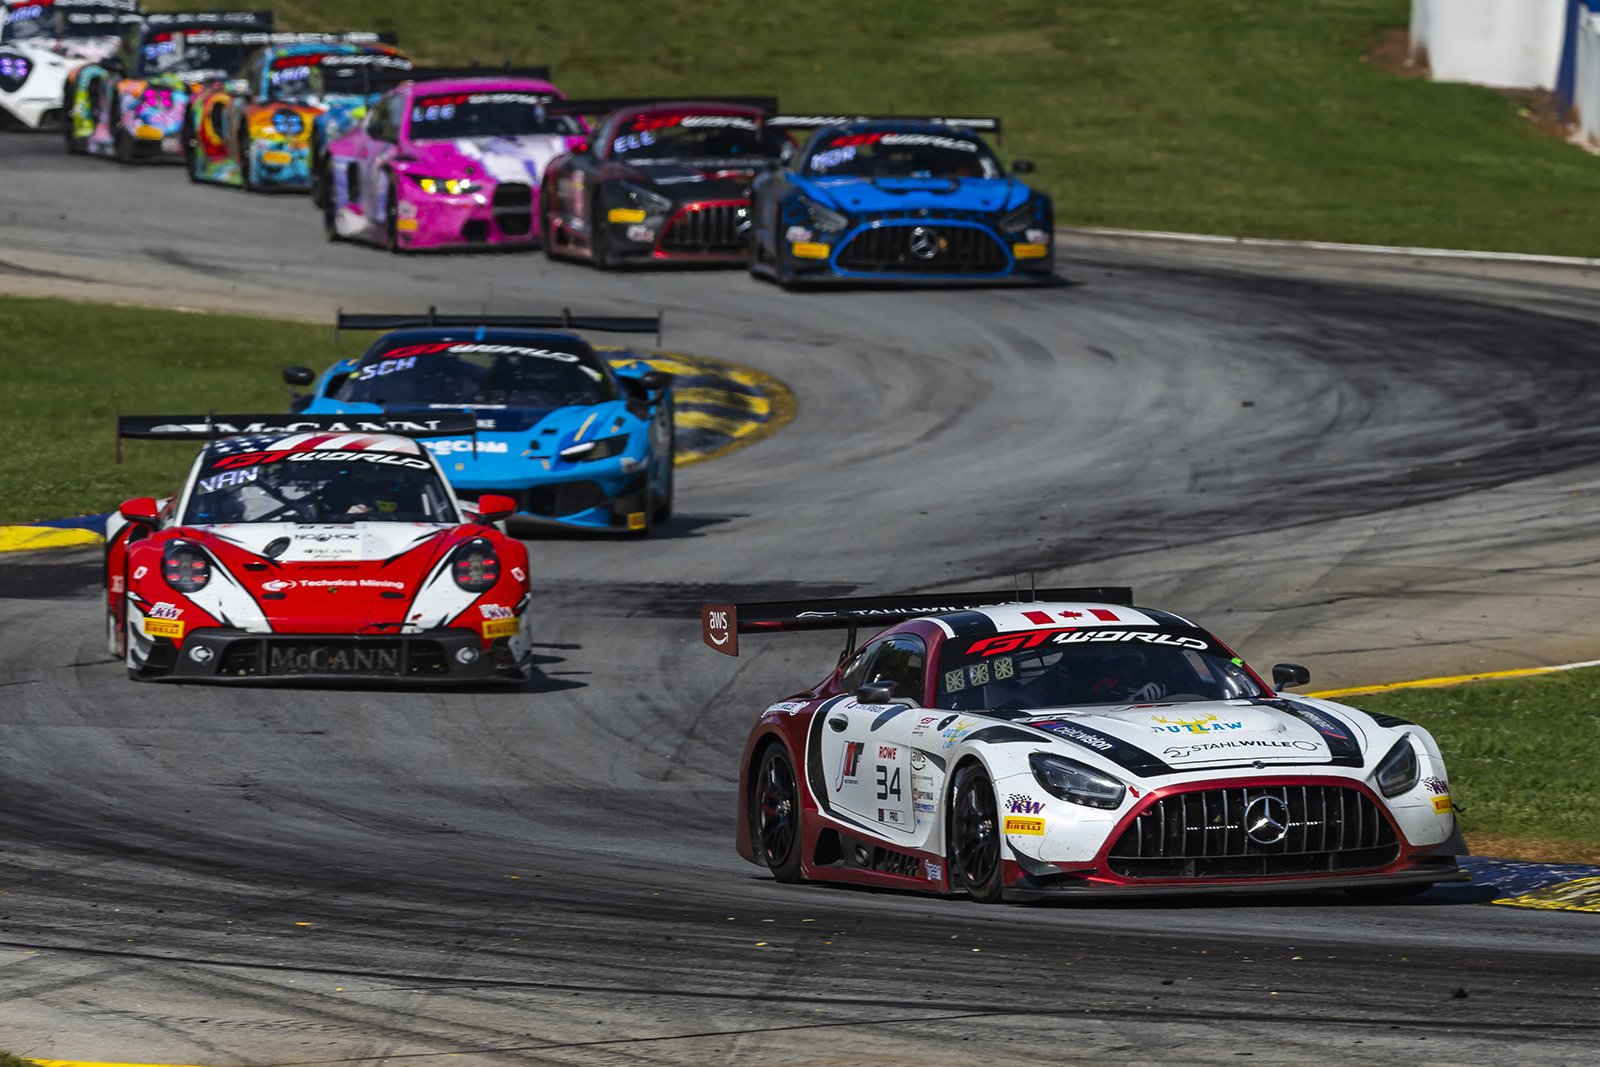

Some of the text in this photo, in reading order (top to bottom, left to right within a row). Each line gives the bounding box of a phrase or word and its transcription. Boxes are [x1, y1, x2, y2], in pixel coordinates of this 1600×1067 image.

[448, 344, 580, 363] WORLD
[359, 356, 417, 381] SCH
[286, 452, 432, 470] WORLD
[199, 466, 259, 493] VAN
[359, 580, 404, 589] Mining
[709, 610, 728, 630] aws
[964, 628, 1209, 657] GT WORLD
[270, 647, 399, 670] McCANN
[879, 745, 897, 760] ROWE
[1191, 740, 1292, 752] STAHLWILLE
[912, 751, 926, 763] aws
[876, 765, 901, 802] 34
[1010, 800, 1046, 815] KW
[1006, 820, 1042, 831] PIRELLI
